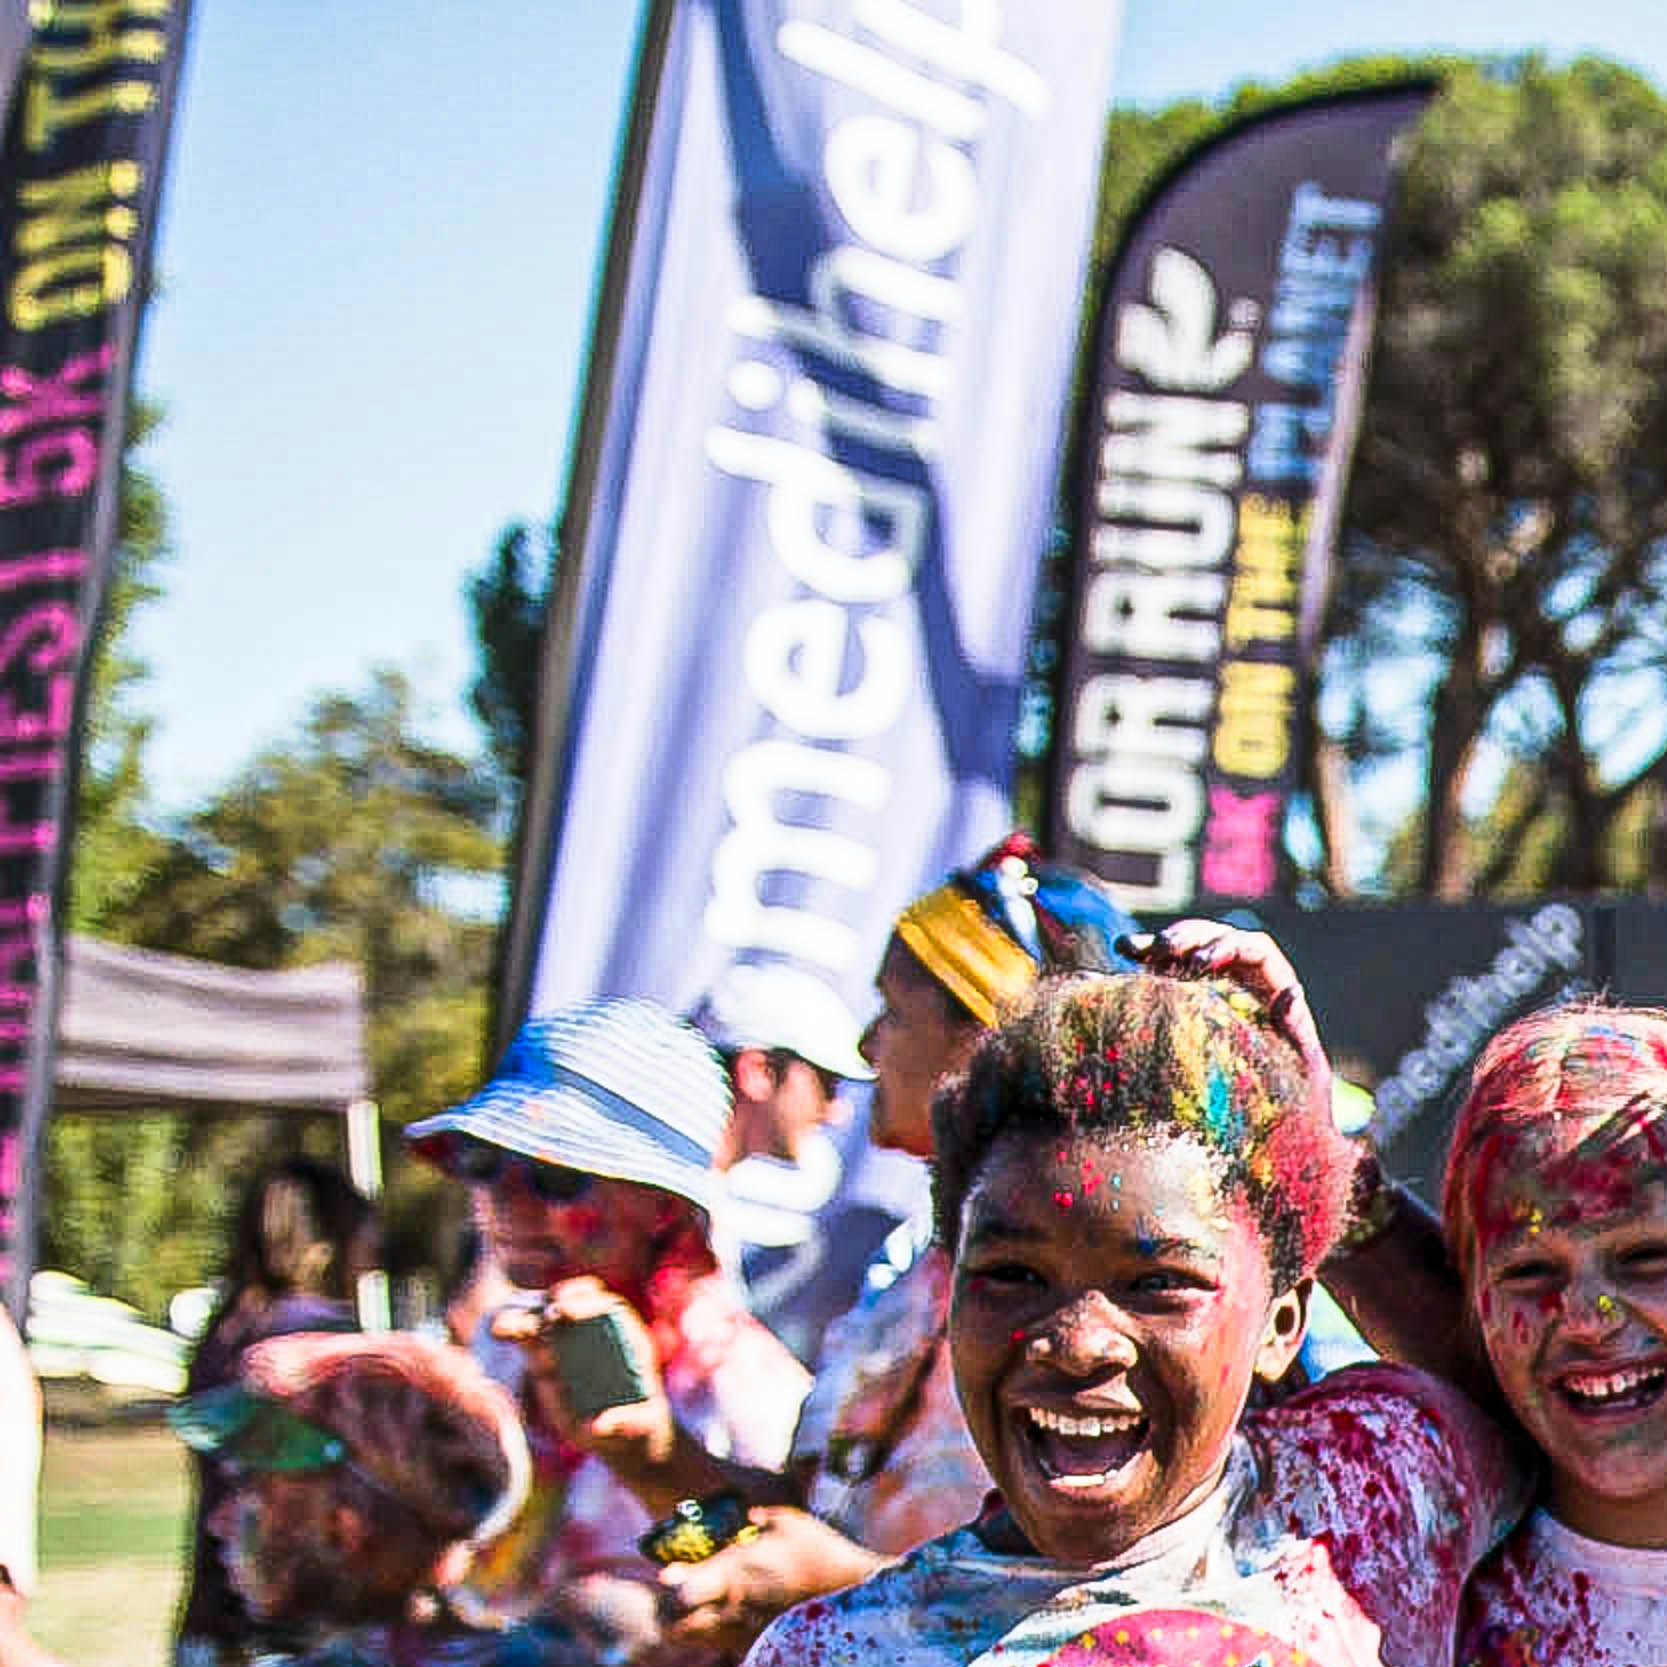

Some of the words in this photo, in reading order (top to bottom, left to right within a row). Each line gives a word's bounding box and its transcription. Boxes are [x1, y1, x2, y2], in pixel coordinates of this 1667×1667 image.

[8, 158, 140, 332] ON
[1082, 393, 1252, 662] RUN
[1211, 660, 1298, 778] ON
